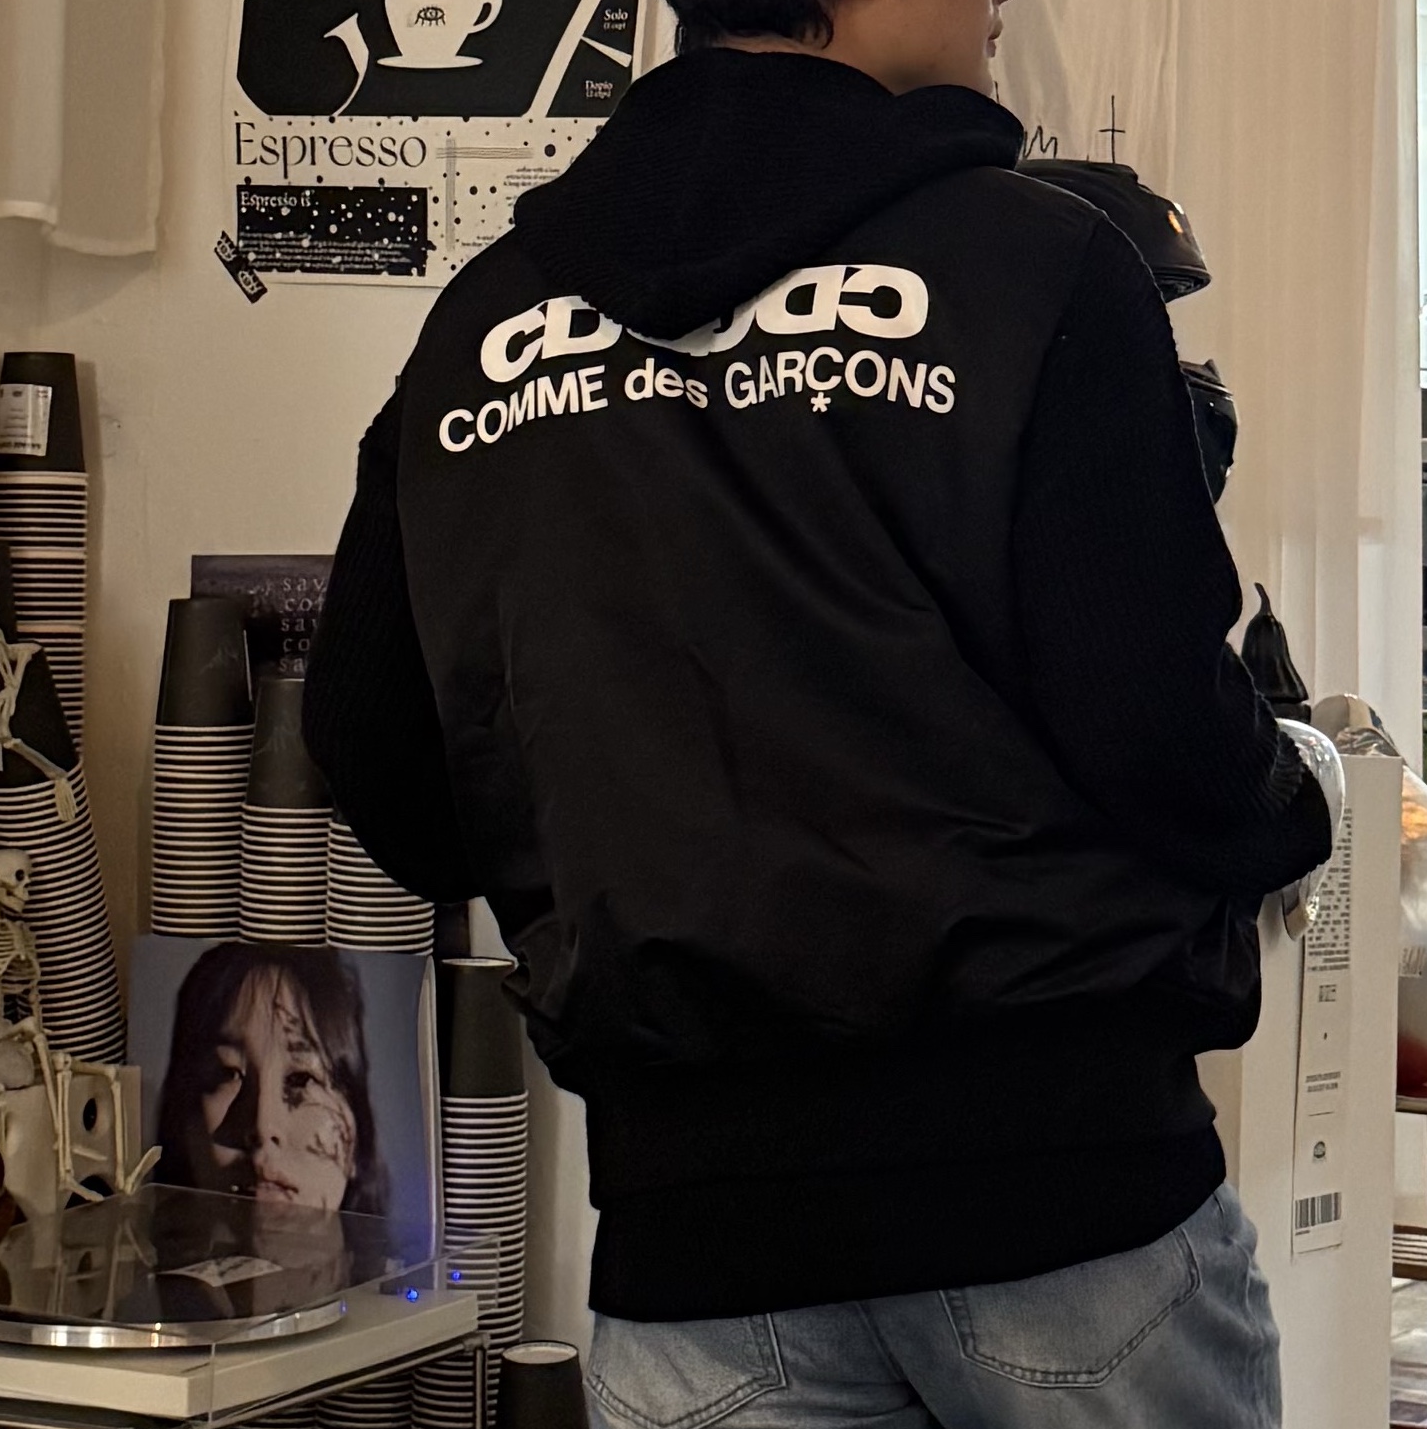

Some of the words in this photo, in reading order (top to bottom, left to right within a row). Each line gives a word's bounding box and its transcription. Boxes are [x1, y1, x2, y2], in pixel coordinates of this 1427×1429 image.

[603, 8, 629, 21] Solo
[236, 122, 427, 179] Espresso
[240, 191, 298, 210] Espresso
[439, 365, 608, 452] COMME
[624, 357, 708, 409] des
[283, 577, 326, 591] sav
